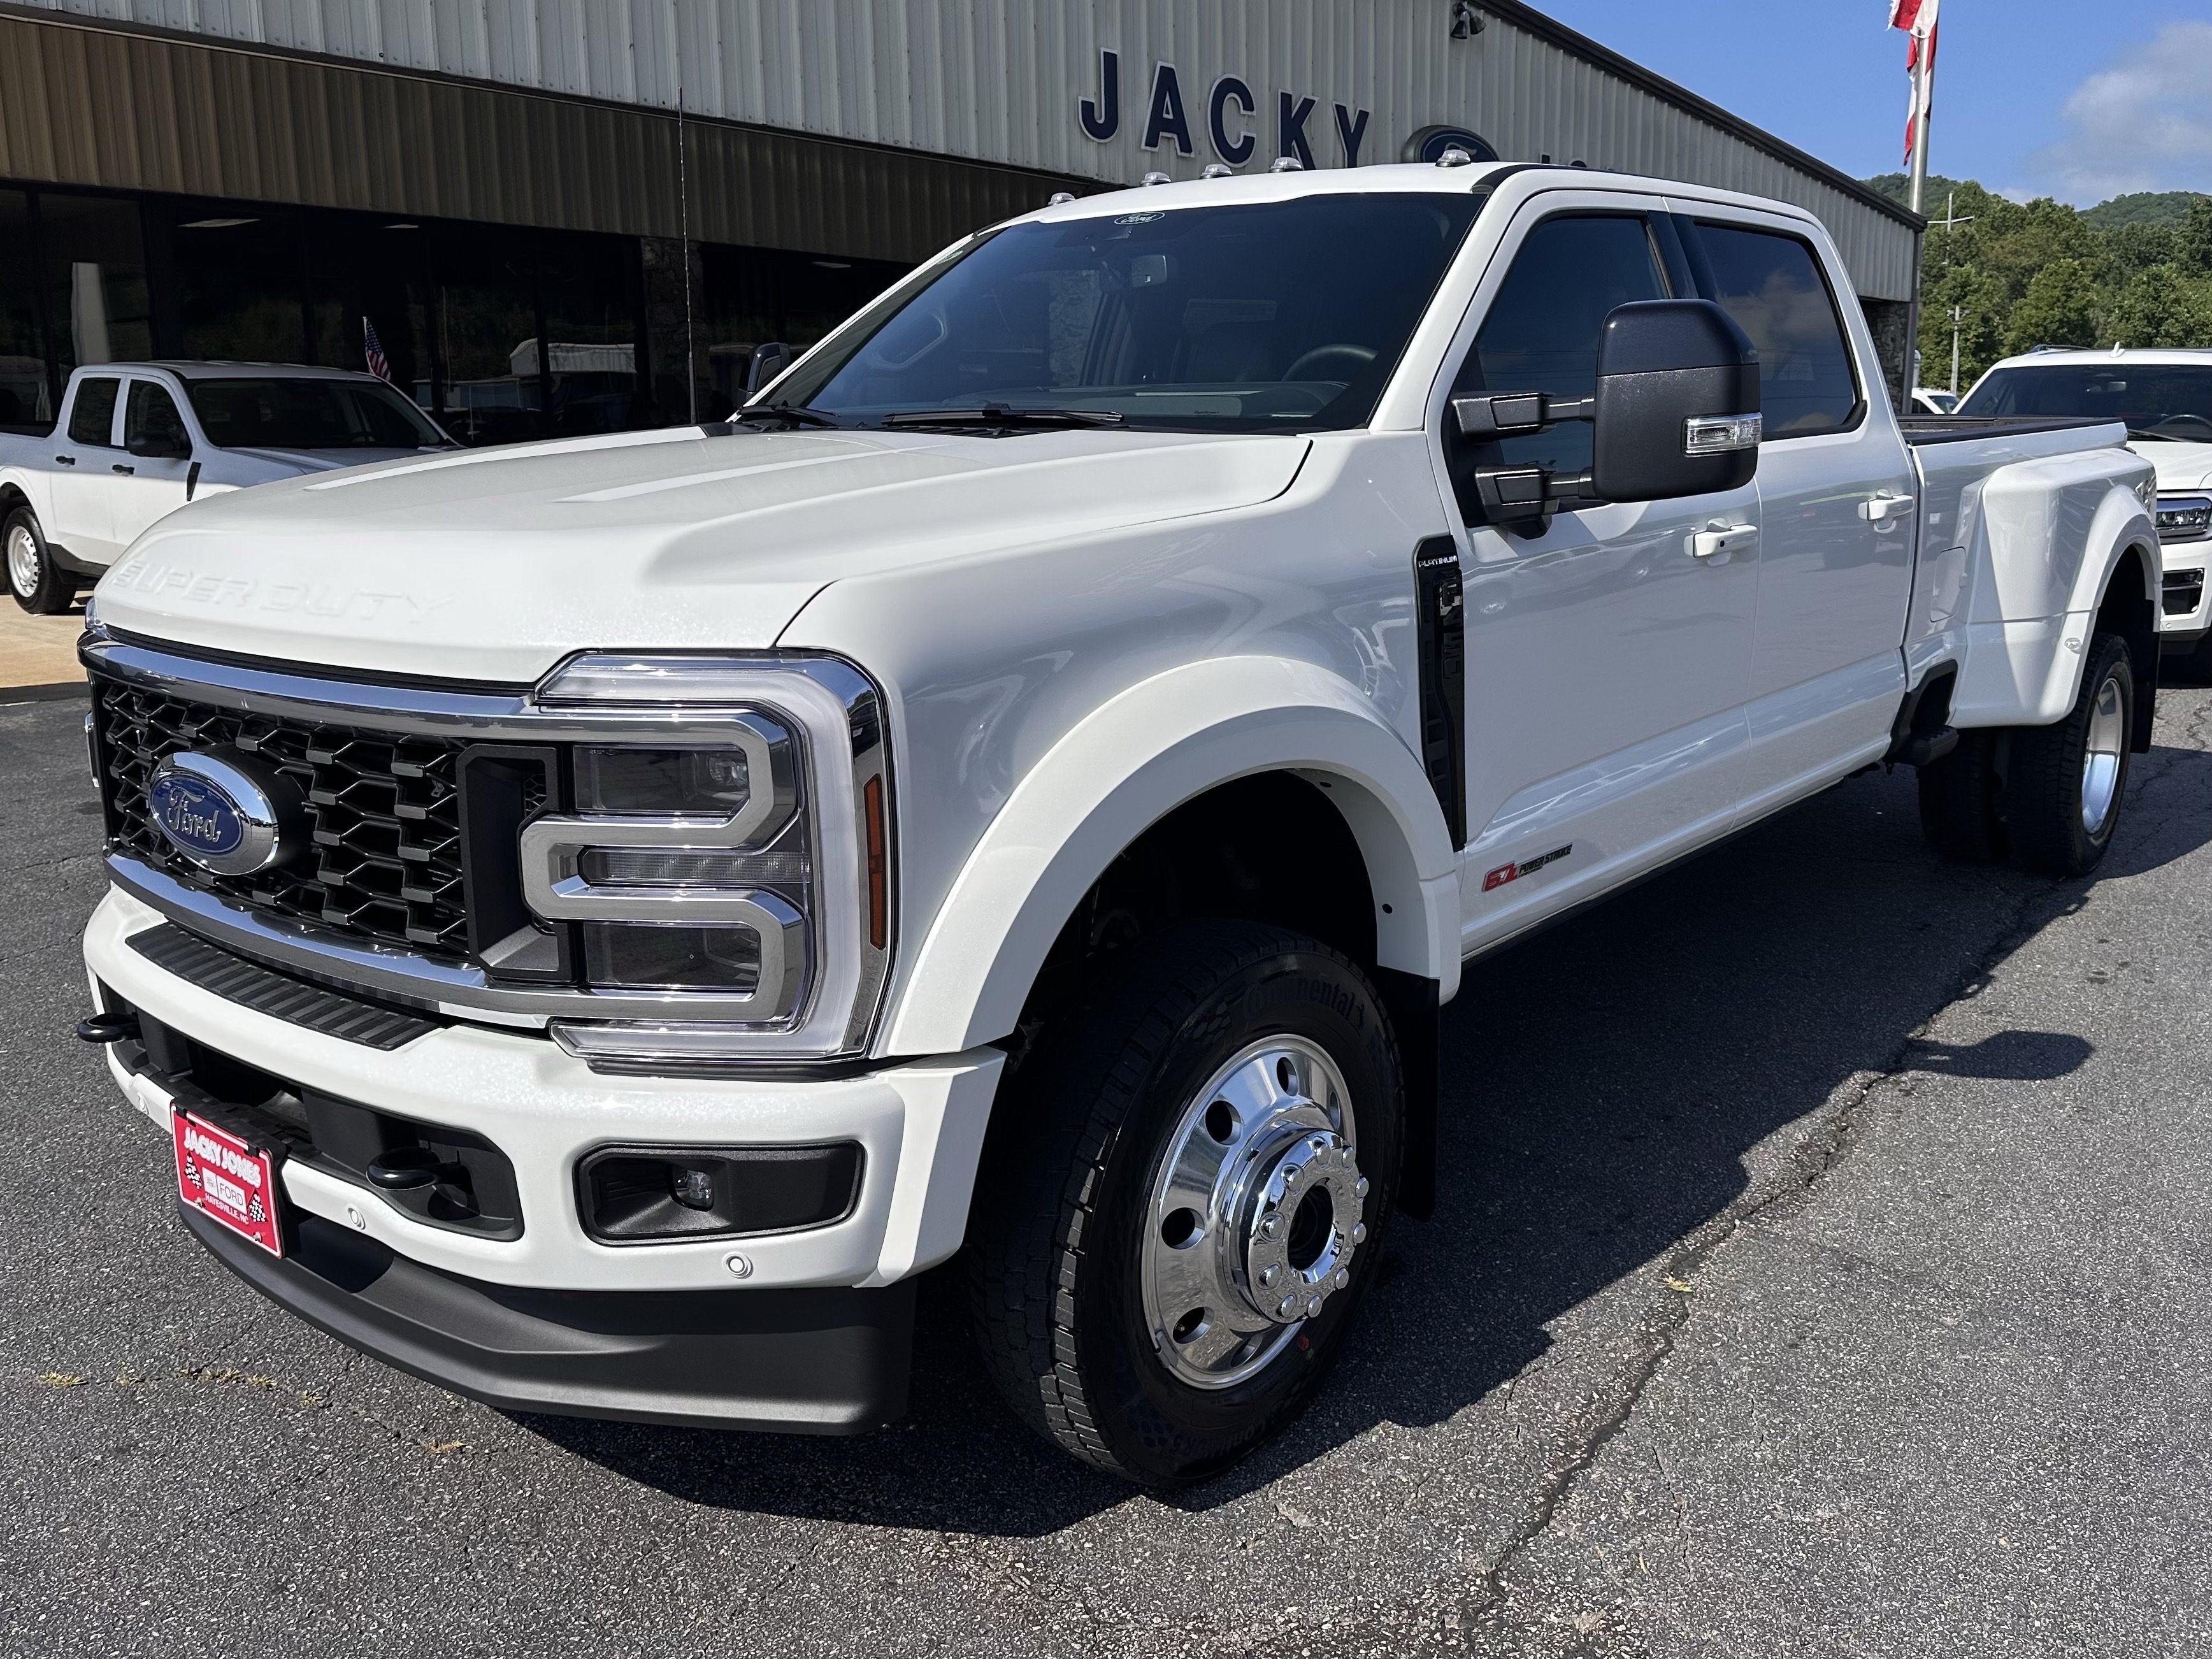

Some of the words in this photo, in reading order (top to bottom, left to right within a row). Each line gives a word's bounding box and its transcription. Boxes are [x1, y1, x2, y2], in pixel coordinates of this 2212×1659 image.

[1078, 47, 1370, 171] JACKY
[1418, 556, 1458, 568] PLATINUM
[113, 559, 256, 607] SUPER
[259, 582, 455, 622] DUTY
[166, 786, 221, 843] Ford
[1519, 856, 1544, 874] POWER
[184, 1126, 221, 1166] JACKY
[222, 1147, 261, 1188] JONES
[220, 1182, 243, 1206] FORD
[240, 1212, 249, 1224] NC
